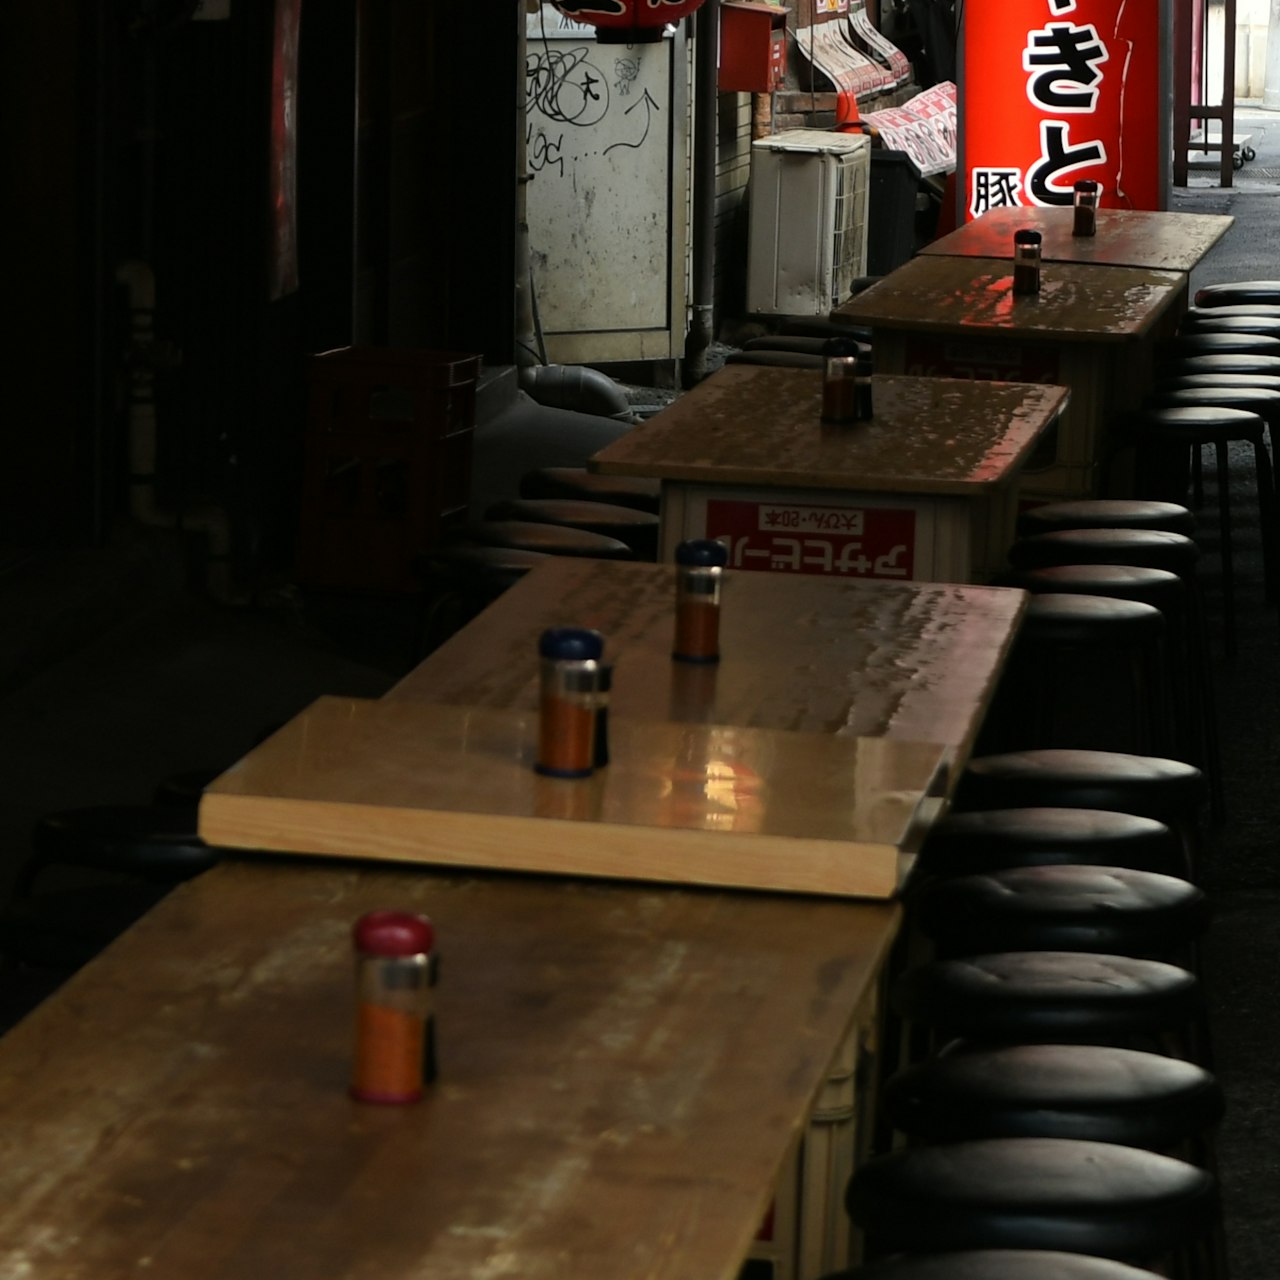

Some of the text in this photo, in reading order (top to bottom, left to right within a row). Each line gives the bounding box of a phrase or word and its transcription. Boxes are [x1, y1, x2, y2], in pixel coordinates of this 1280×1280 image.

[764, 509, 858, 531] 大びん・20本
[714, 534, 908, 577] アサヒビール
